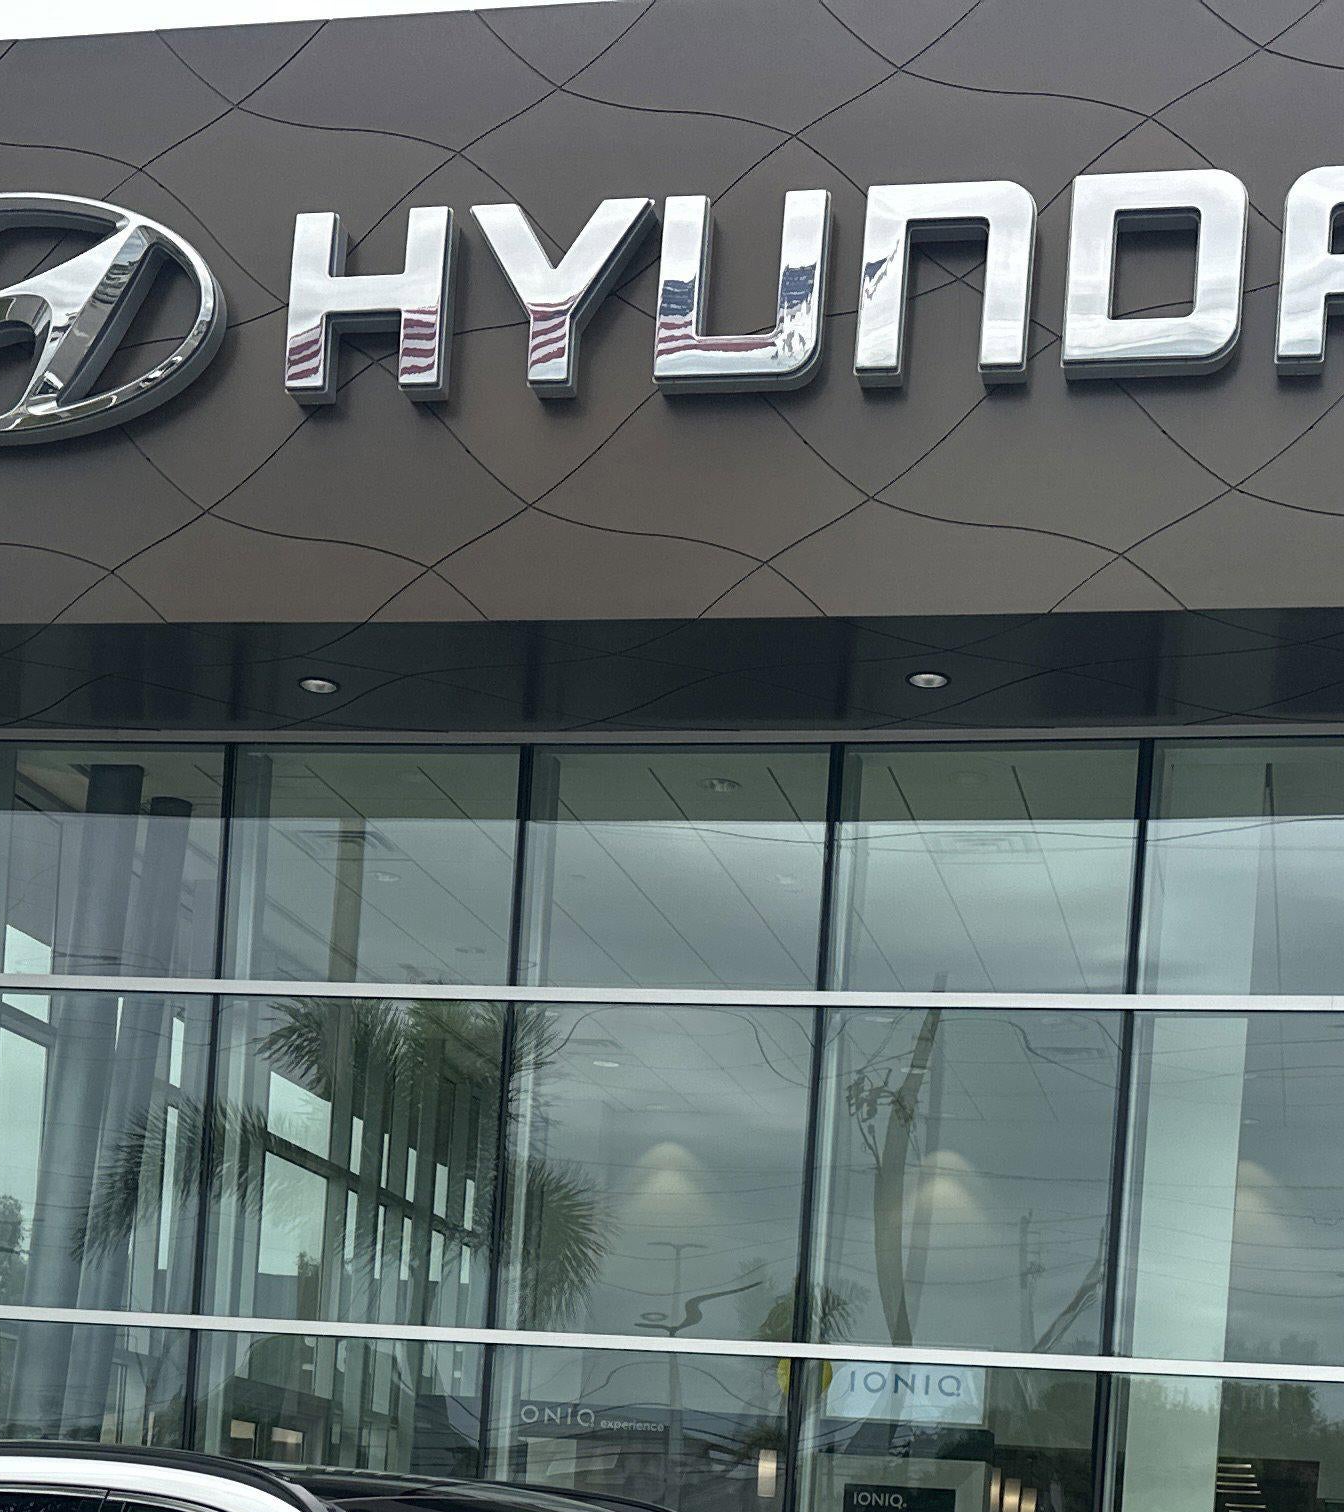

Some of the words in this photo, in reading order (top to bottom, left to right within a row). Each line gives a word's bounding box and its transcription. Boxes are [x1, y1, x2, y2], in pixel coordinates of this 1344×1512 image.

[850, 1370, 961, 1398] IONIQ
[520, 1404, 595, 1428] ONIQ
[600, 1417, 665, 1433] experience
